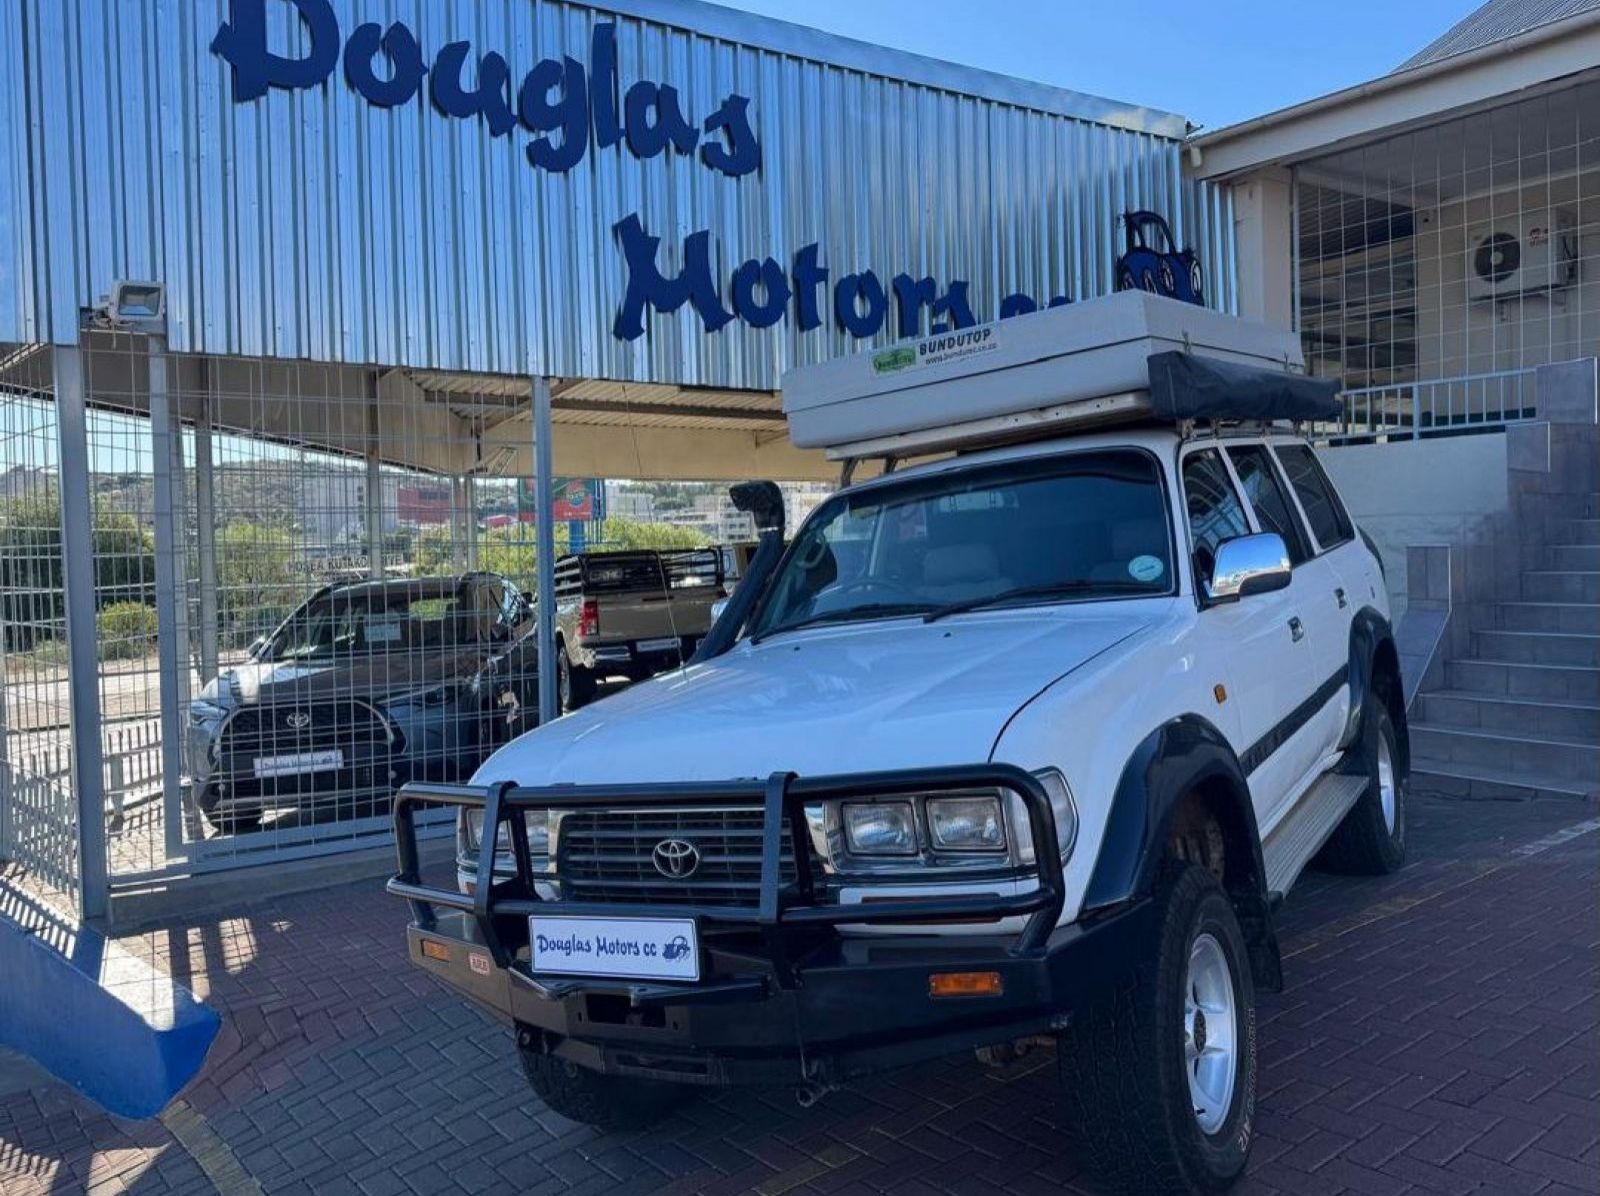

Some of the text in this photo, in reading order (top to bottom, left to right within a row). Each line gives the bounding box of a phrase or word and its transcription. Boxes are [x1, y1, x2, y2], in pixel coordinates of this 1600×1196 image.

[211, 0, 762, 177] Douglas
[612, 212, 977, 342] Motors
[919, 328, 991, 356] BUNDUTOP
[536, 933, 657, 957] Douglas Motors cc
